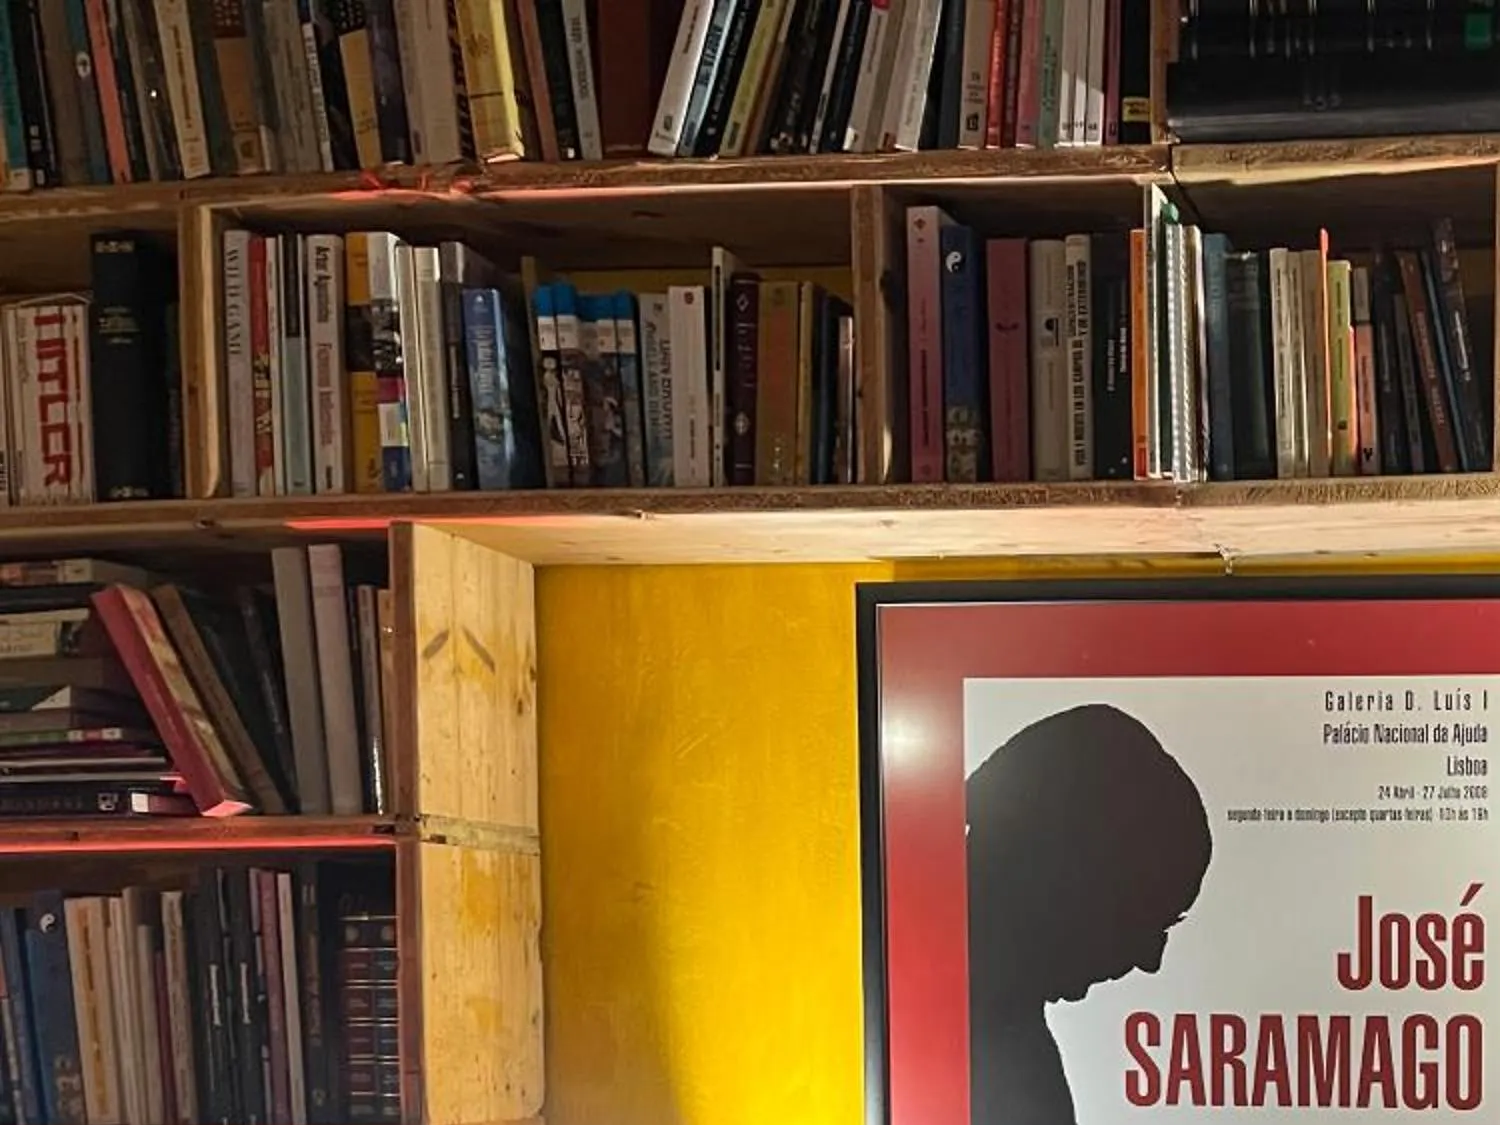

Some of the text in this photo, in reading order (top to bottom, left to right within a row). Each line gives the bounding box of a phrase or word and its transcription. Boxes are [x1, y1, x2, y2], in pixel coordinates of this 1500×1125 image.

[1325, 690, 1393, 711] Galeria
[1405, 690, 1422, 711] D.
[1433, 687, 1472, 711] Luís
[1323, 721, 1489, 748] Palácio Nacional da Ajuda
[1446, 754, 1489, 777] Lisboa
[1377, 785, 1391, 799] 24
[1393, 785, 1415, 799] Abril
[1422, 785, 1435, 799] 27
[1437, 785, 1462, 799] Julho
[1336, 882, 1487, 992] José
[1124, 1010, 1484, 1112] SARAMAGO
